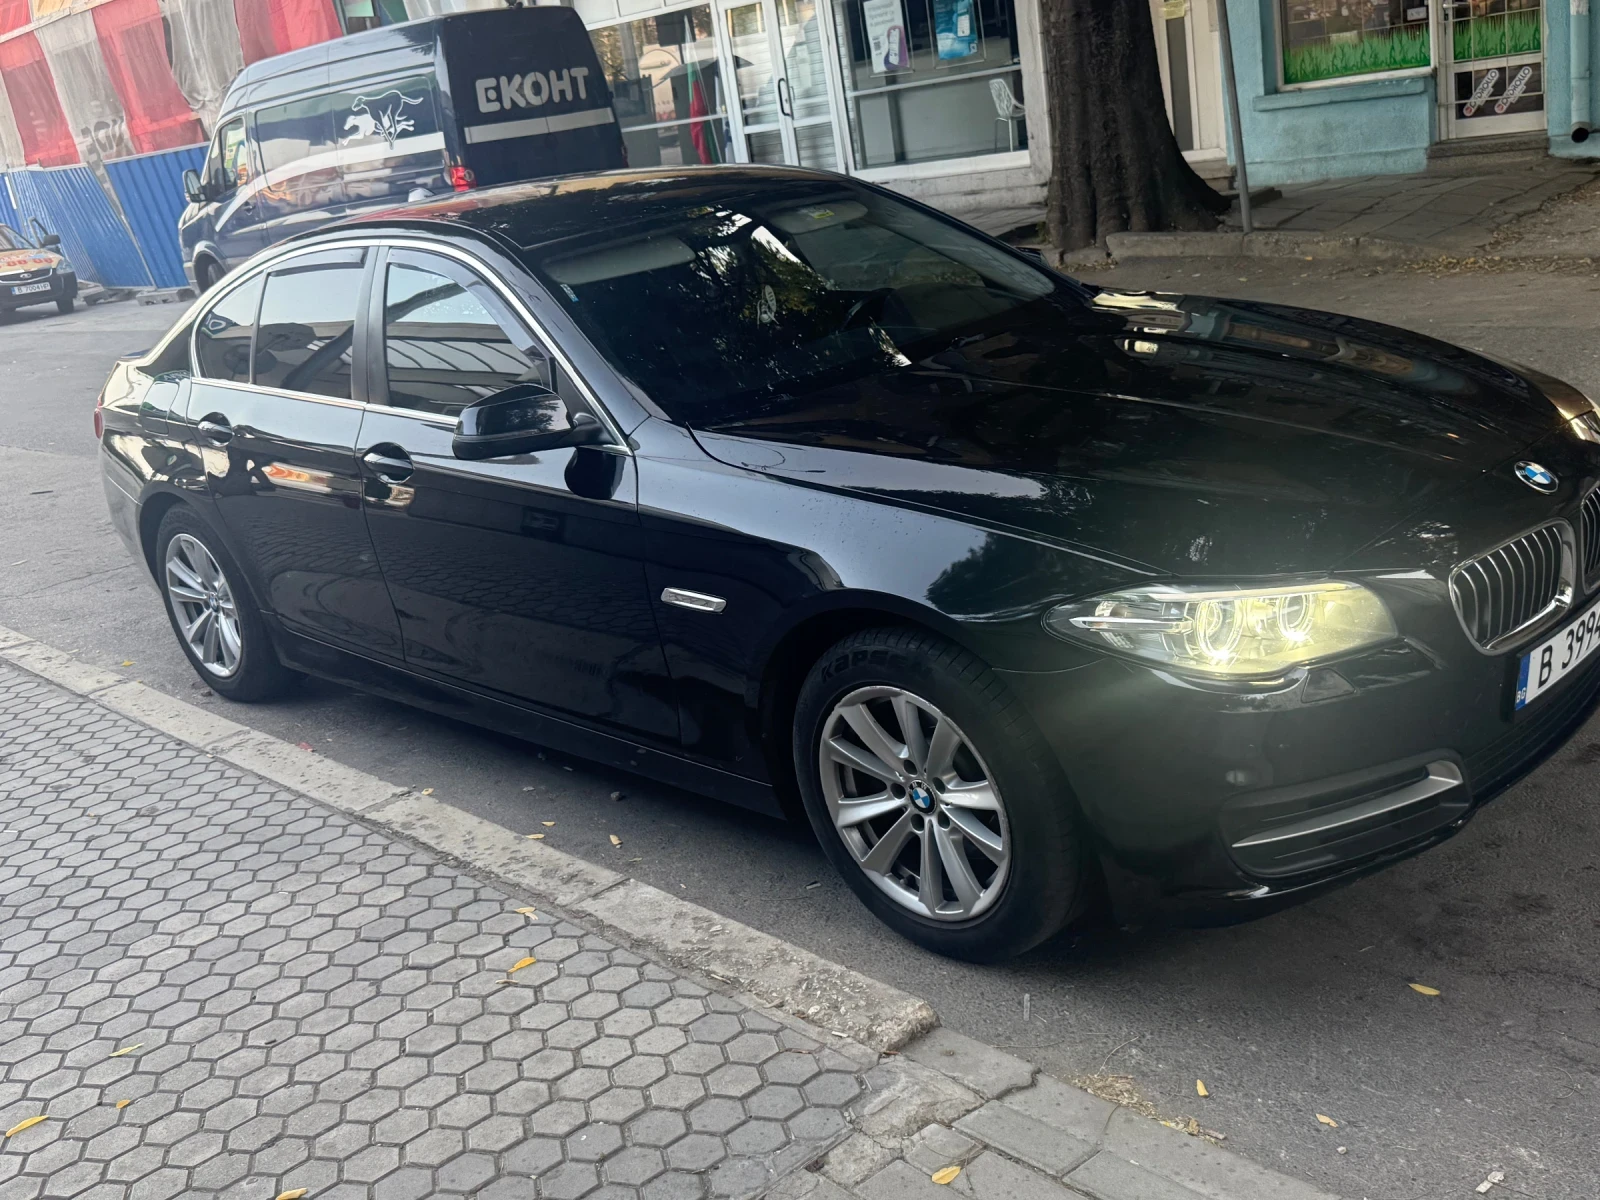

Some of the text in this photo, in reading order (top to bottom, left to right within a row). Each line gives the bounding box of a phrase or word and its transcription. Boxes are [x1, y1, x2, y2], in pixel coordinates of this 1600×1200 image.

[475, 66, 589, 113] ЕКОНТ
[1537, 644, 1553, 689] B
[1516, 687, 1527, 703] BG
